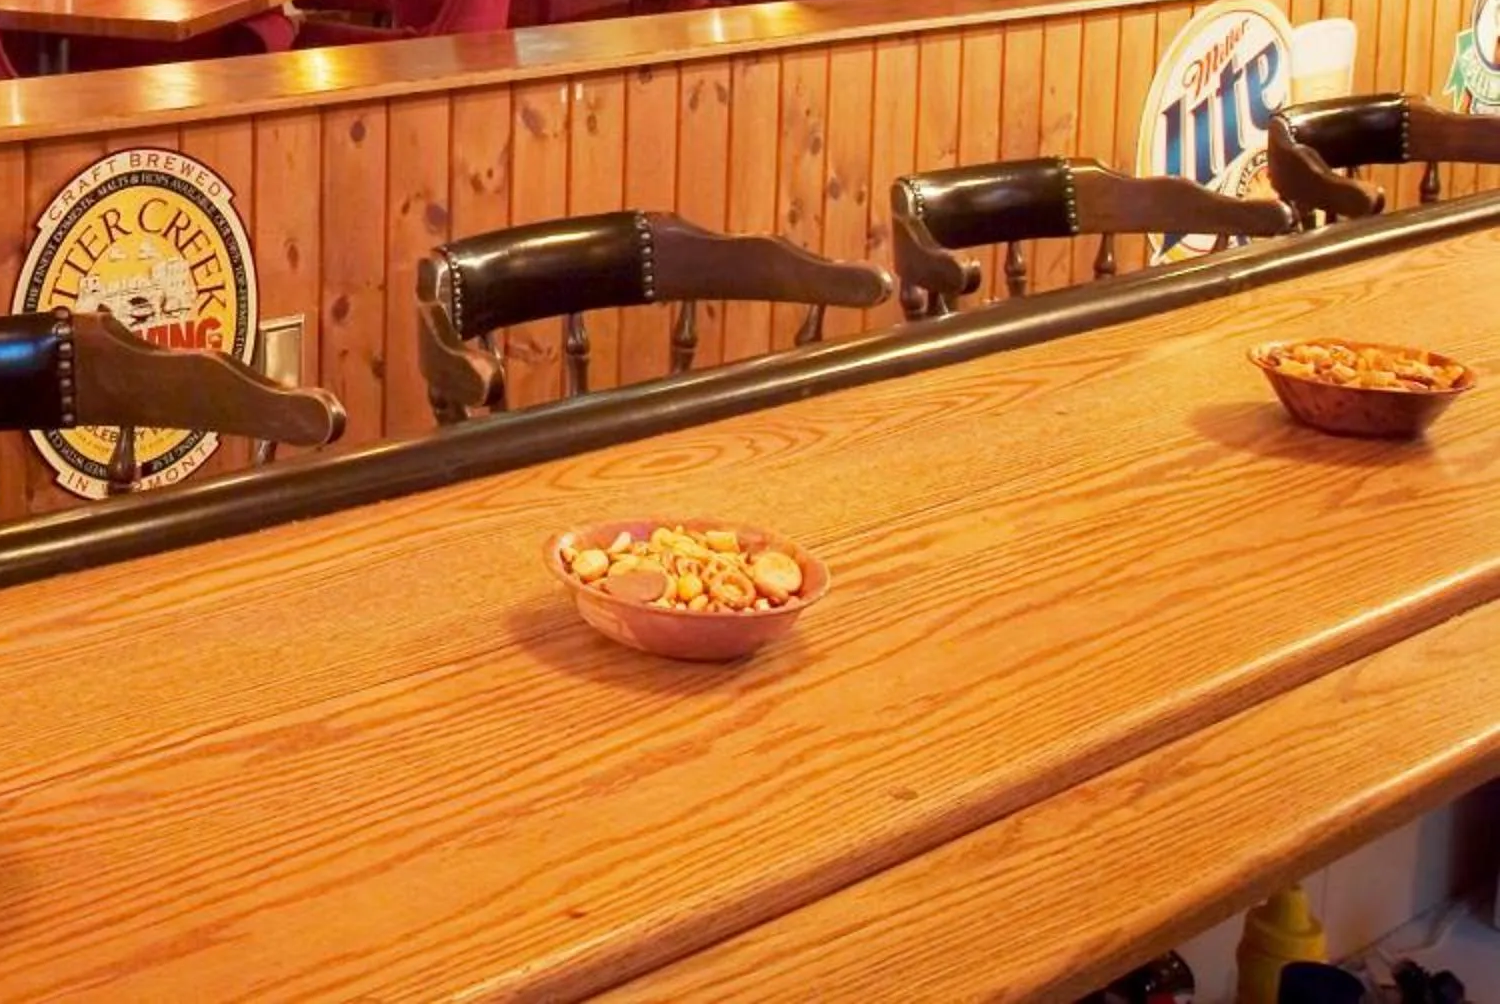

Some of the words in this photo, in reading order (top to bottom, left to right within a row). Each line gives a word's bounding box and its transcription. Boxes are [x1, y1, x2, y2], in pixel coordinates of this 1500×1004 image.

[1182, 18, 1250, 98] Miller
[49, 159, 117, 221] CRAFT
[129, 153, 221, 197] BREWED
[48, 208, 132, 305] TTER
[137, 197, 228, 317] CREEK
[66, 469, 89, 492] IN
